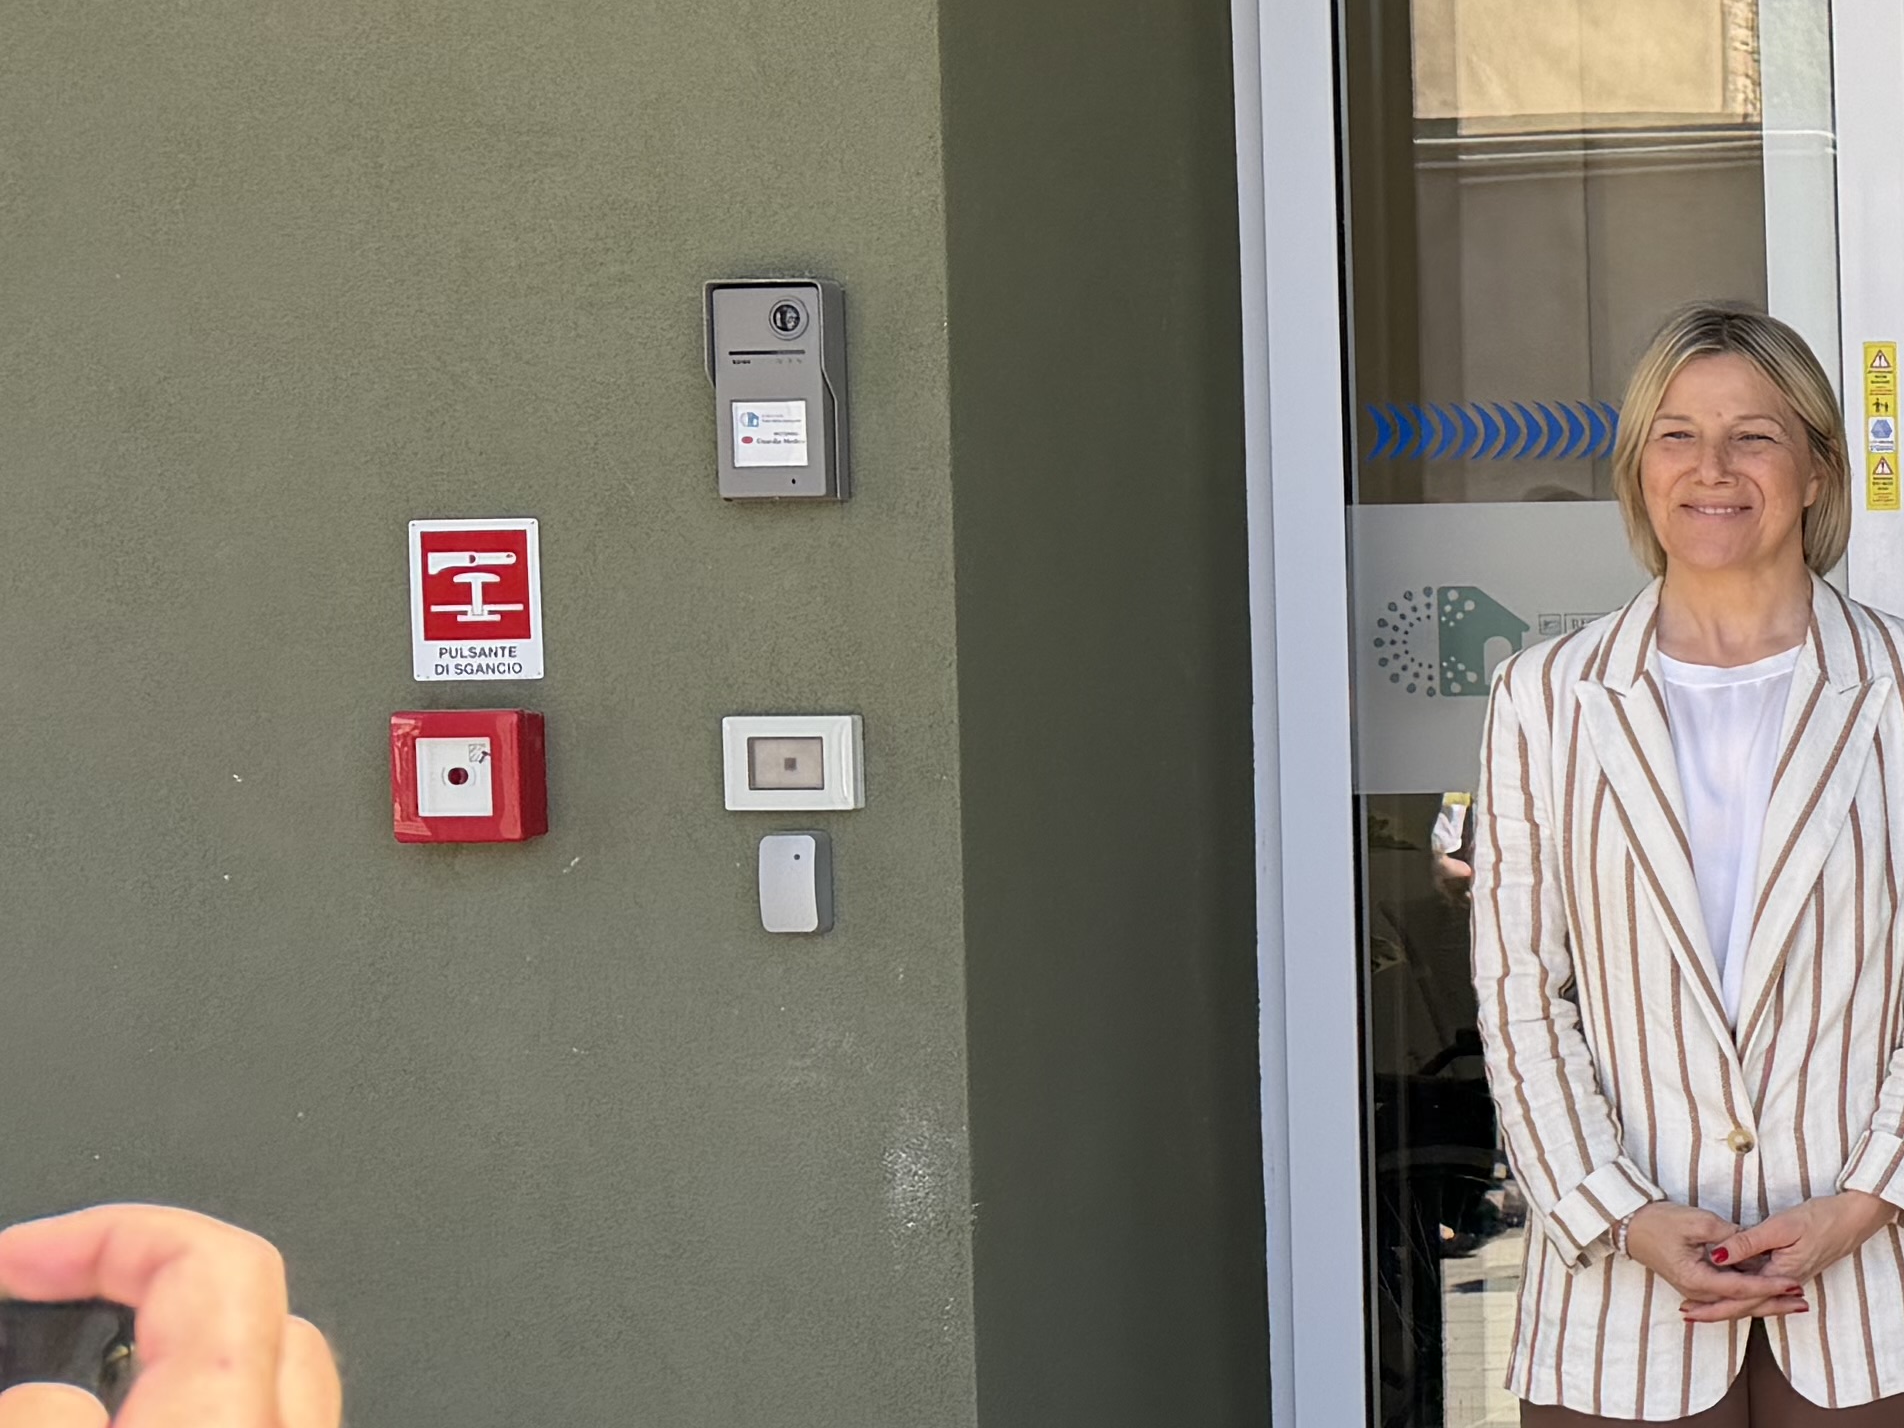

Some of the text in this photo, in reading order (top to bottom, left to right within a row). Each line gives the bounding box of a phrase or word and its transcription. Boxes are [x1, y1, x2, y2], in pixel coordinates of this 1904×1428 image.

[438, 645, 517, 659] PULSANTE
[434, 662, 522, 675] DI SGANCIO
